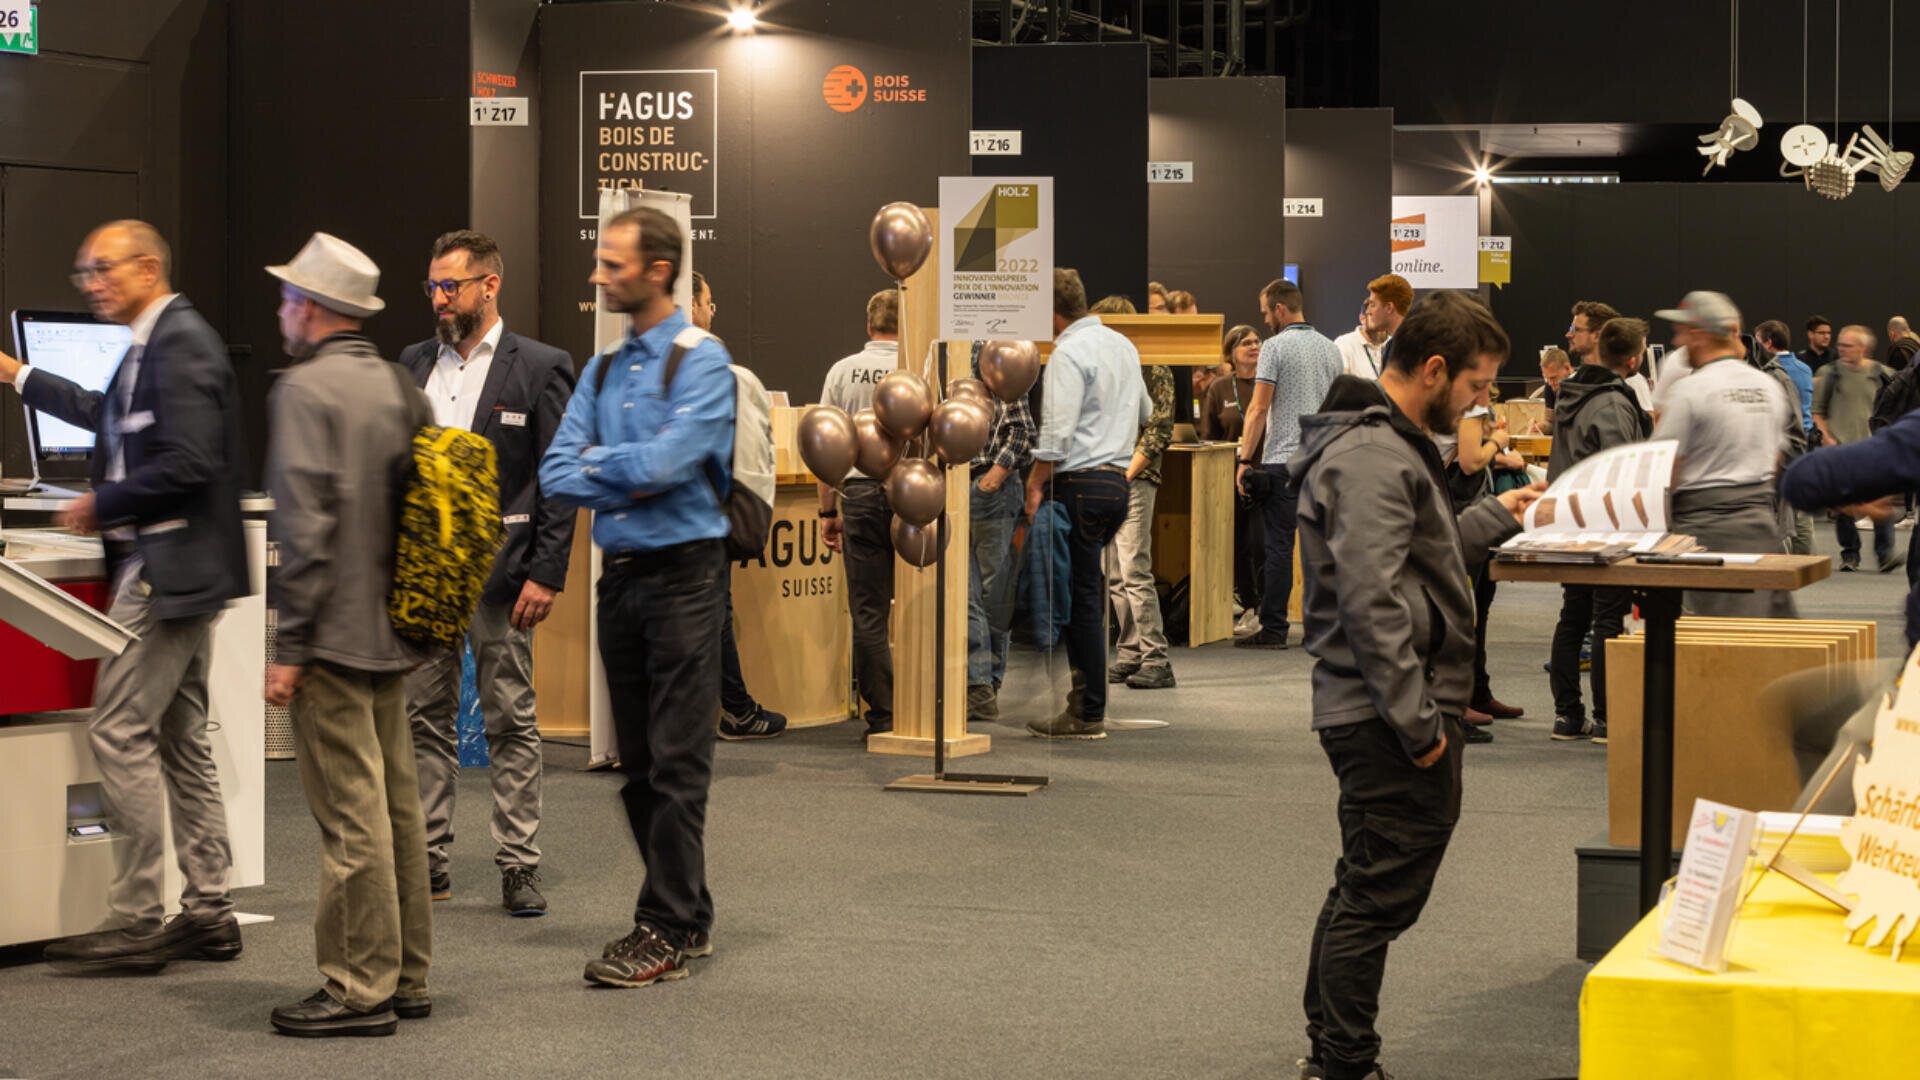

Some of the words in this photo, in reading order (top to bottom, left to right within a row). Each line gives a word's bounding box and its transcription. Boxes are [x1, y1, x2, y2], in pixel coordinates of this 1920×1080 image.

[873, 75, 910, 88] BOIS
[873, 89, 928, 102] SUISSE
[600, 91, 694, 120] FAGUS
[491, 107, 517, 121] Z17
[600, 127, 645, 146] BOIS
[650, 127, 675, 145] DE
[987, 138, 1010, 151] Z16
[599, 152, 709, 171] CONSTRUC-
[1164, 168, 1184, 180] Z15
[998, 186, 1030, 197] HOLZ
[1297, 204, 1316, 214] Z14
[1403, 229, 1420, 238] Z13
[998, 258, 1039, 273] 2022
[953, 274, 1028, 282] INNOVATIONSPREIS
[953, 283, 971, 291] PRIX
[972, 283, 982, 291] DE
[953, 292, 996, 300] GEWINNER
[851, 368, 890, 385] FAG
[782, 576, 832, 598] SUISSE
[1857, 832, 1920, 882] Werkzeu
